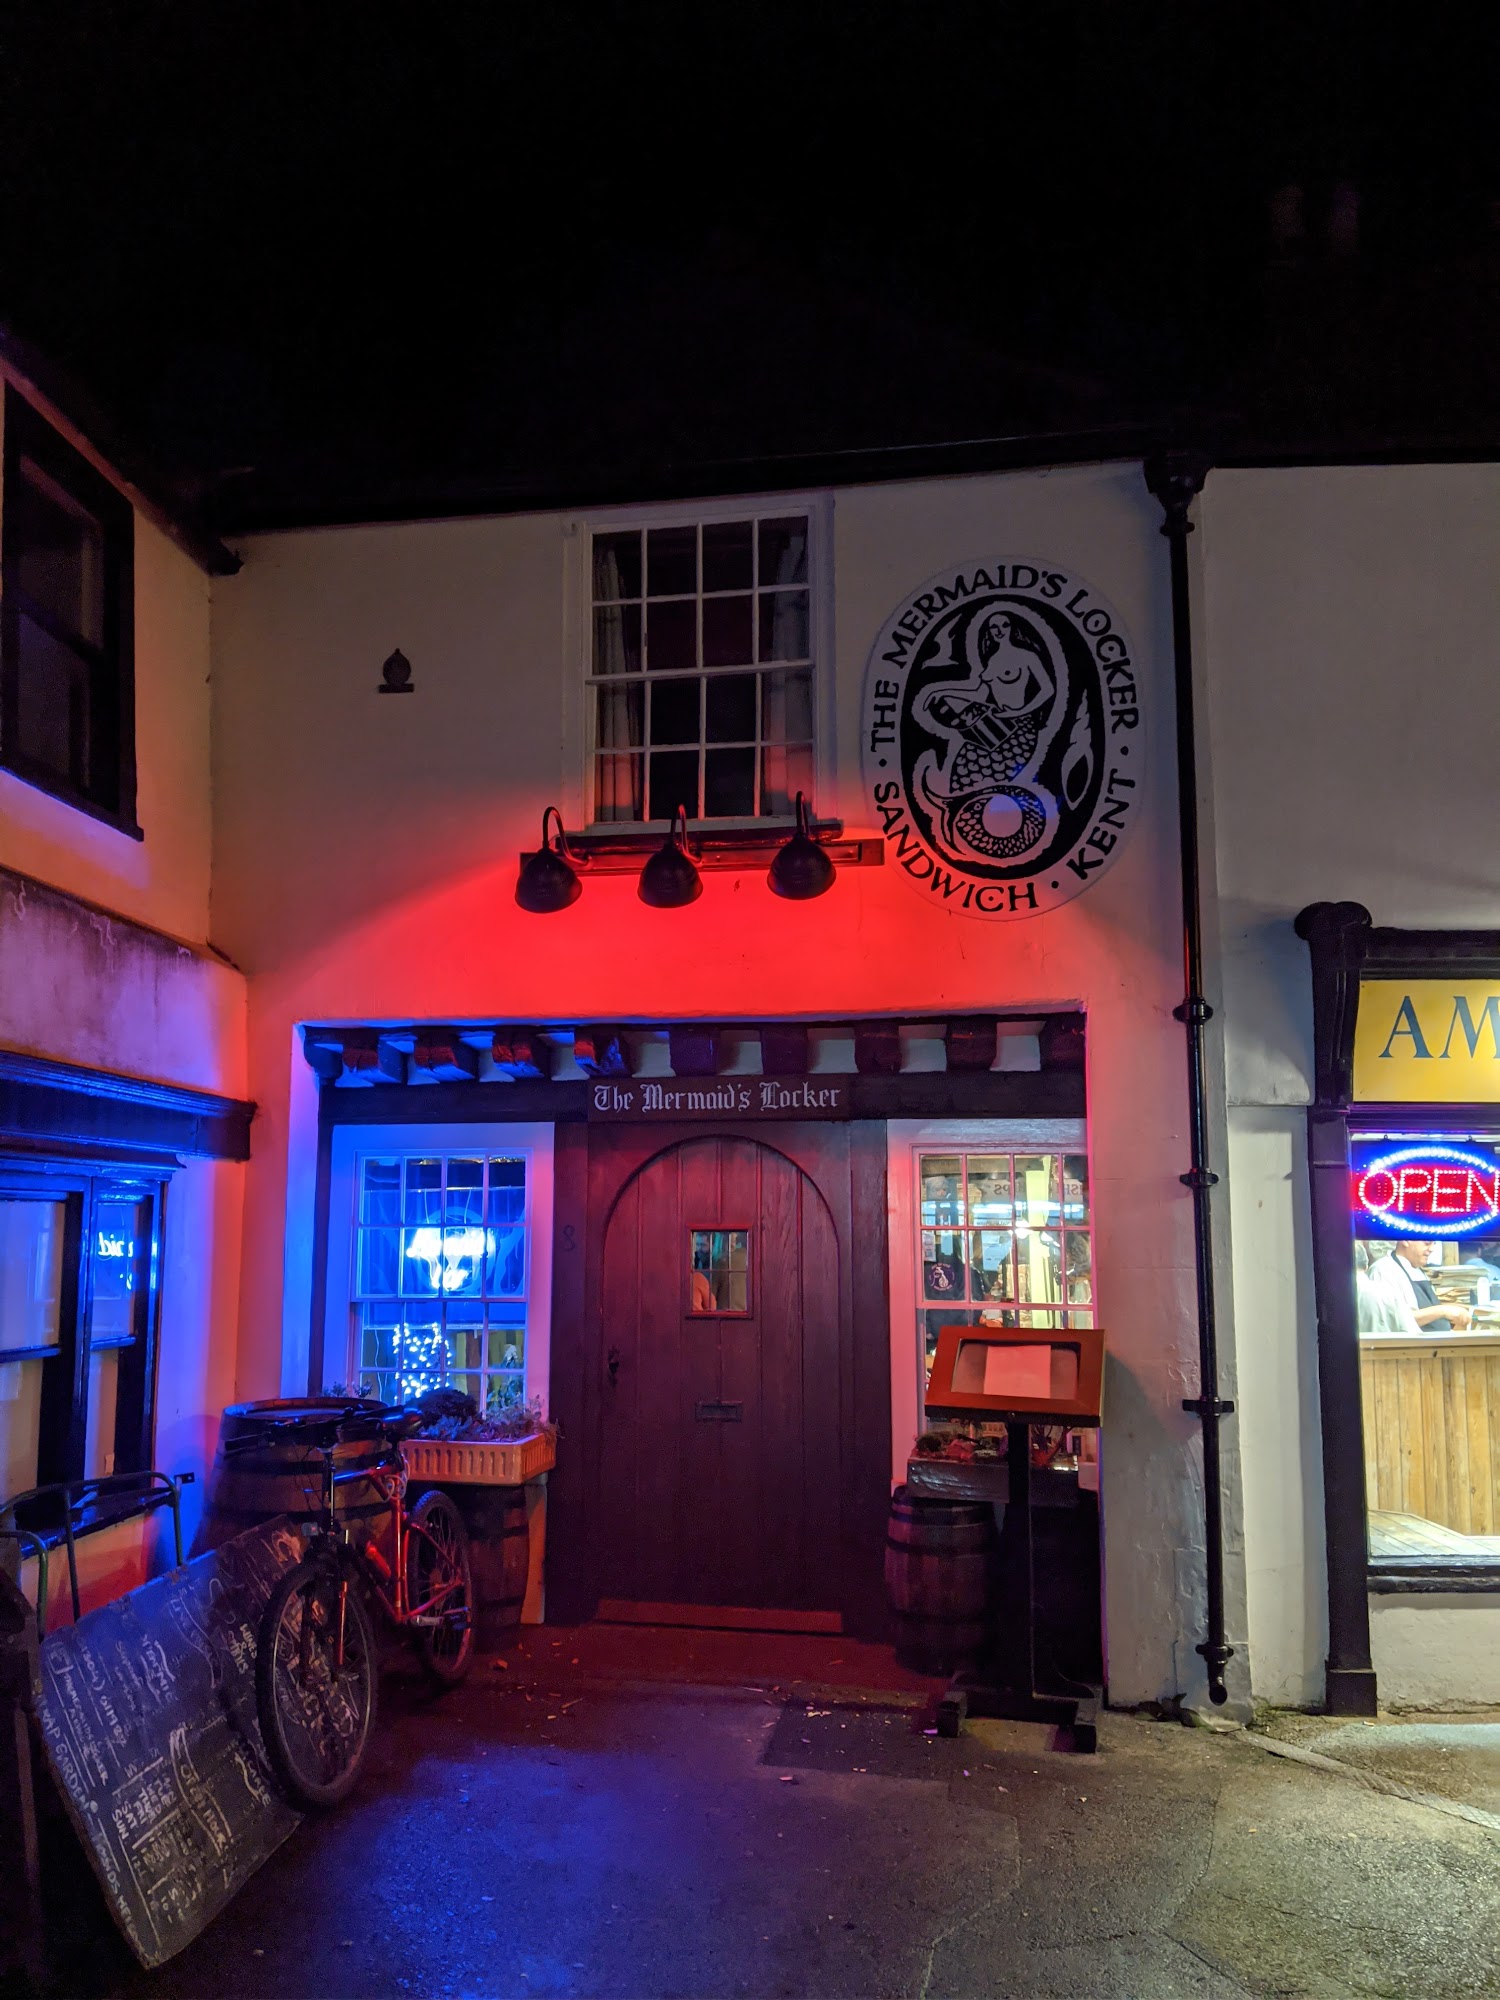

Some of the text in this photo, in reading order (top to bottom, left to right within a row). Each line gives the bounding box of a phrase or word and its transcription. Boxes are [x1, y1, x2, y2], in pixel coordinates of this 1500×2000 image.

[870, 565, 1140, 753] THE MERMAID'S LOCKER
[873, 780, 1040, 912] SANDWICH
[1066, 768, 1136, 880] KENT
[594, 1080, 842, 1113] The Mermaid's Locker
[1358, 1168, 1500, 1214] OPEN
[111, 1808, 130, 1840] SUN
[122, 1800, 138, 1829] SAT
